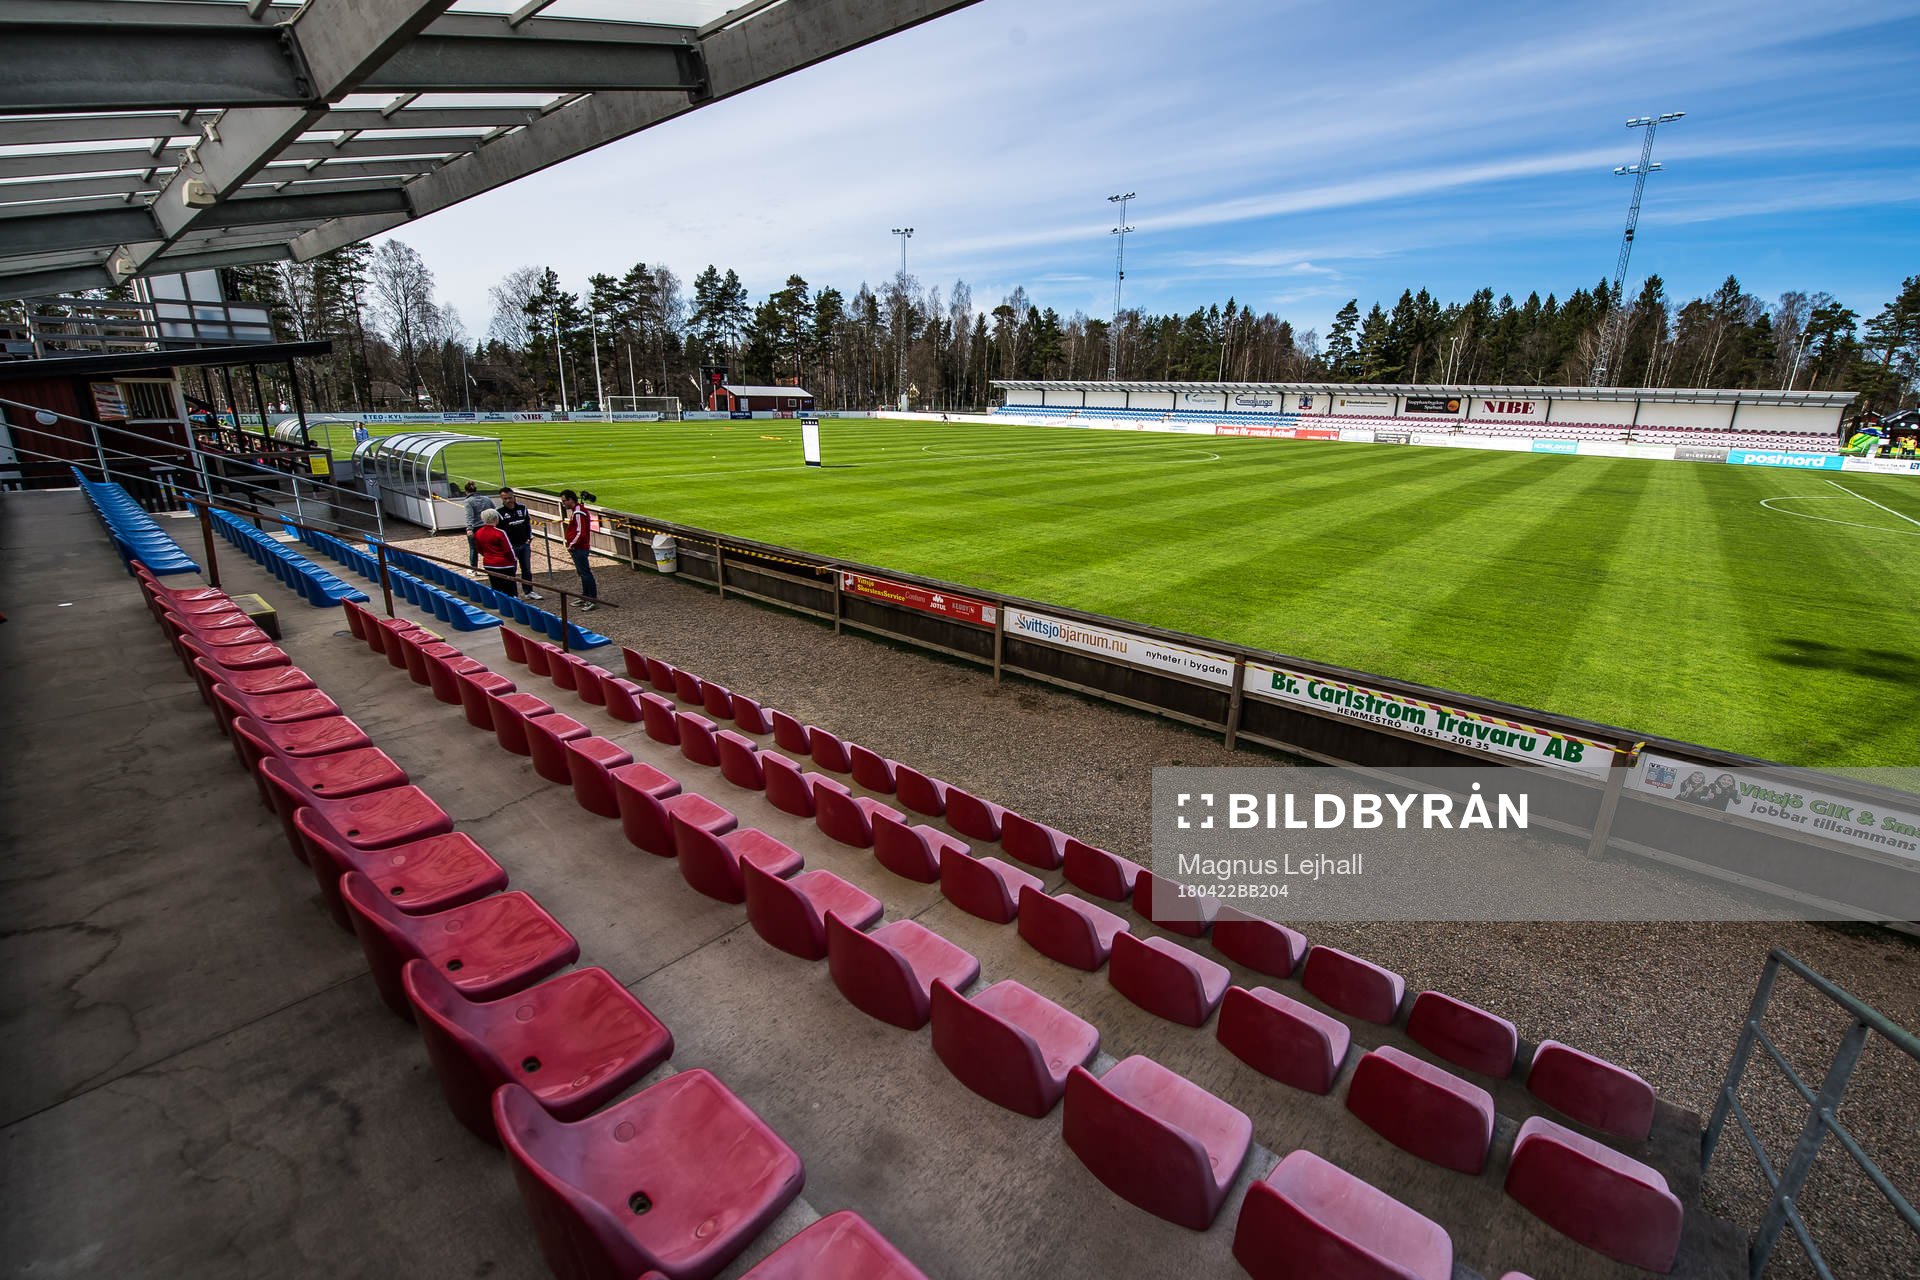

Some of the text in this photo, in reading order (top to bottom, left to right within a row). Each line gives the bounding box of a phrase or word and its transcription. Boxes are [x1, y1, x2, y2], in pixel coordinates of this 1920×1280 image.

[1482, 401, 1535, 414] NIBE
[1743, 453, 1827, 468] postnord
[1025, 618, 1128, 654] vittsjobjarnum.nu
[1146, 651, 1182, 665] nyheter
[1190, 660, 1228, 676] bygden
[1271, 672, 1300, 695] Br.
[1542, 737, 1585, 763] AB
[1337, 706, 1401, 728] HEMMESTRÖ
[1451, 735, 1472, 746] 206
[1475, 741, 1490, 750] 35
[1739, 781, 1804, 809] Vittsjö
[1809, 799, 1854, 822] GIK
[1856, 811, 1876, 827] &
[1750, 802, 1917, 851] jobbar tillsammans
